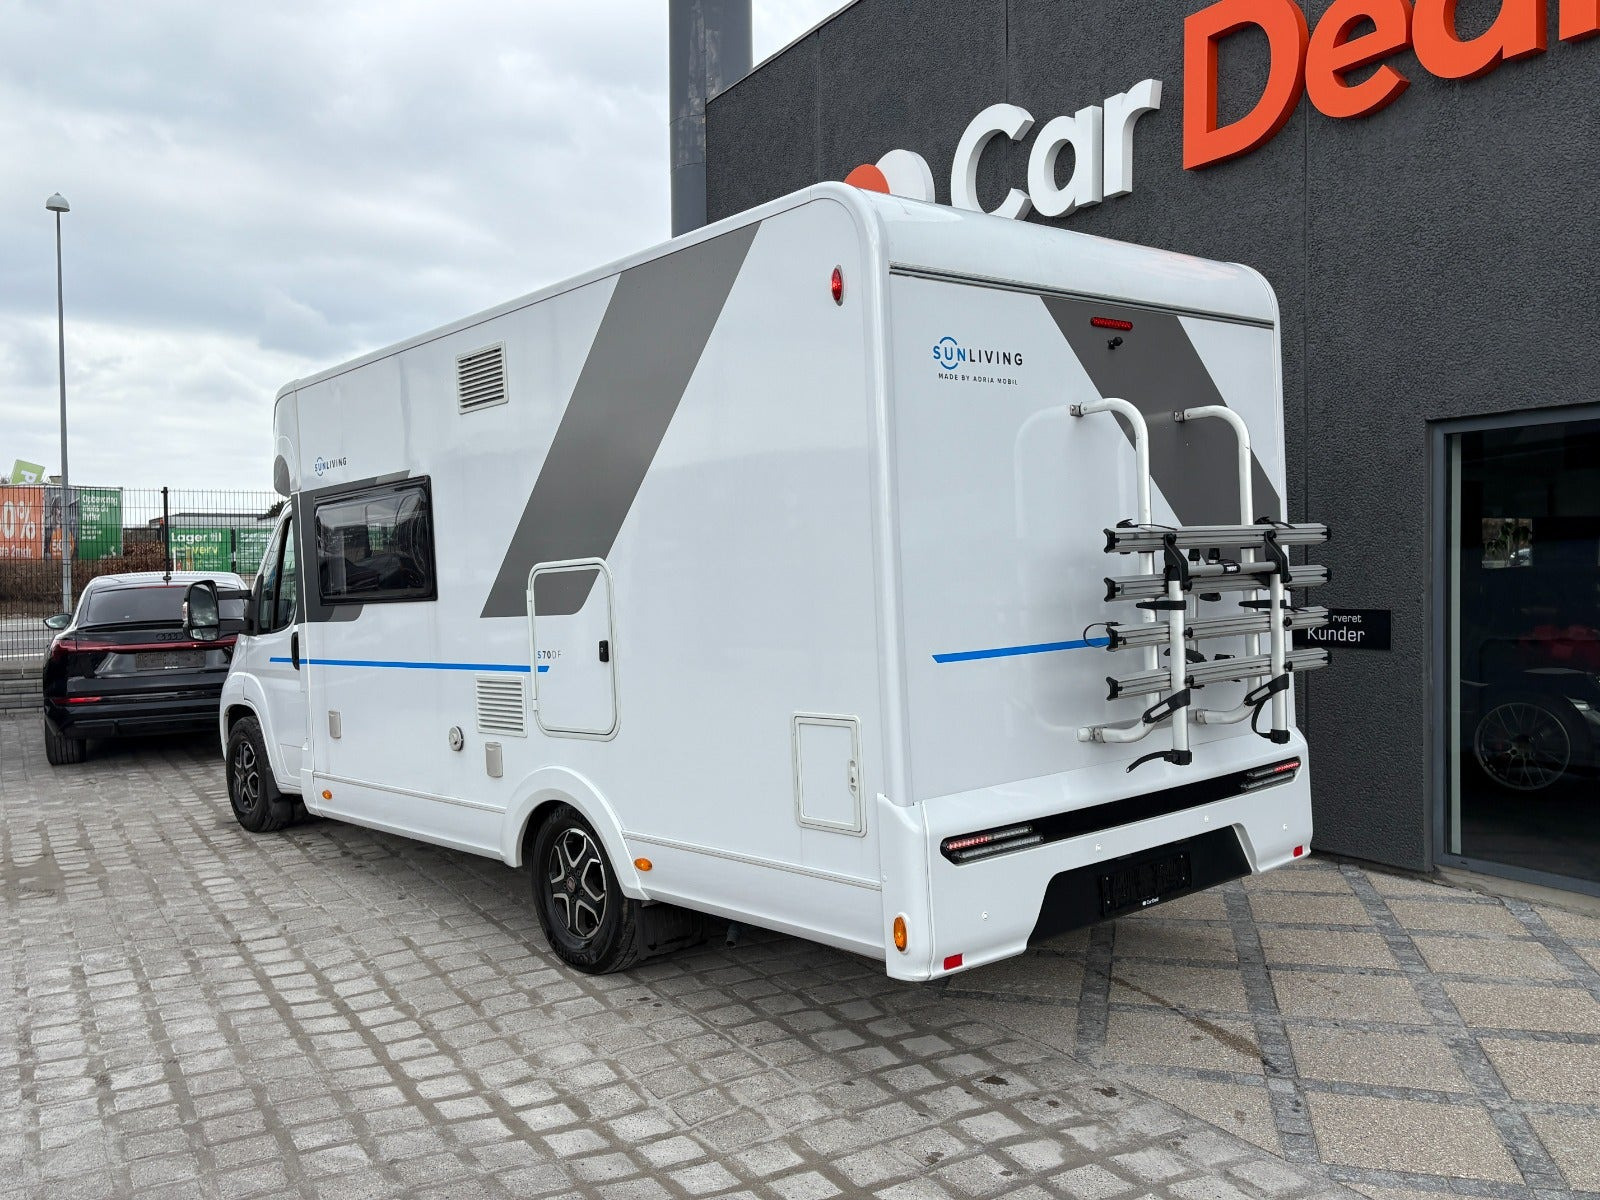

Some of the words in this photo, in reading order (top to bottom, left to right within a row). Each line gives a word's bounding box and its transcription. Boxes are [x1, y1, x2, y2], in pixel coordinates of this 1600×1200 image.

[951, 78, 1163, 220] Car
[1183, 0, 1600, 171] Dea
[932, 343, 1023, 367] SUNLIVING
[938, 372, 958, 381] MADE
[961, 374, 970, 382] BY
[973, 376, 995, 384] ADRIA
[997, 378, 1018, 386] MOBIL
[314, 457, 347, 473] SUNLIVING
[0, 500, 36, 540] 0%
[171, 532, 207, 545] Lager
[210, 532, 222, 542] til
[1332, 614, 1362, 623] rveret
[1307, 625, 1366, 642] Kunder
